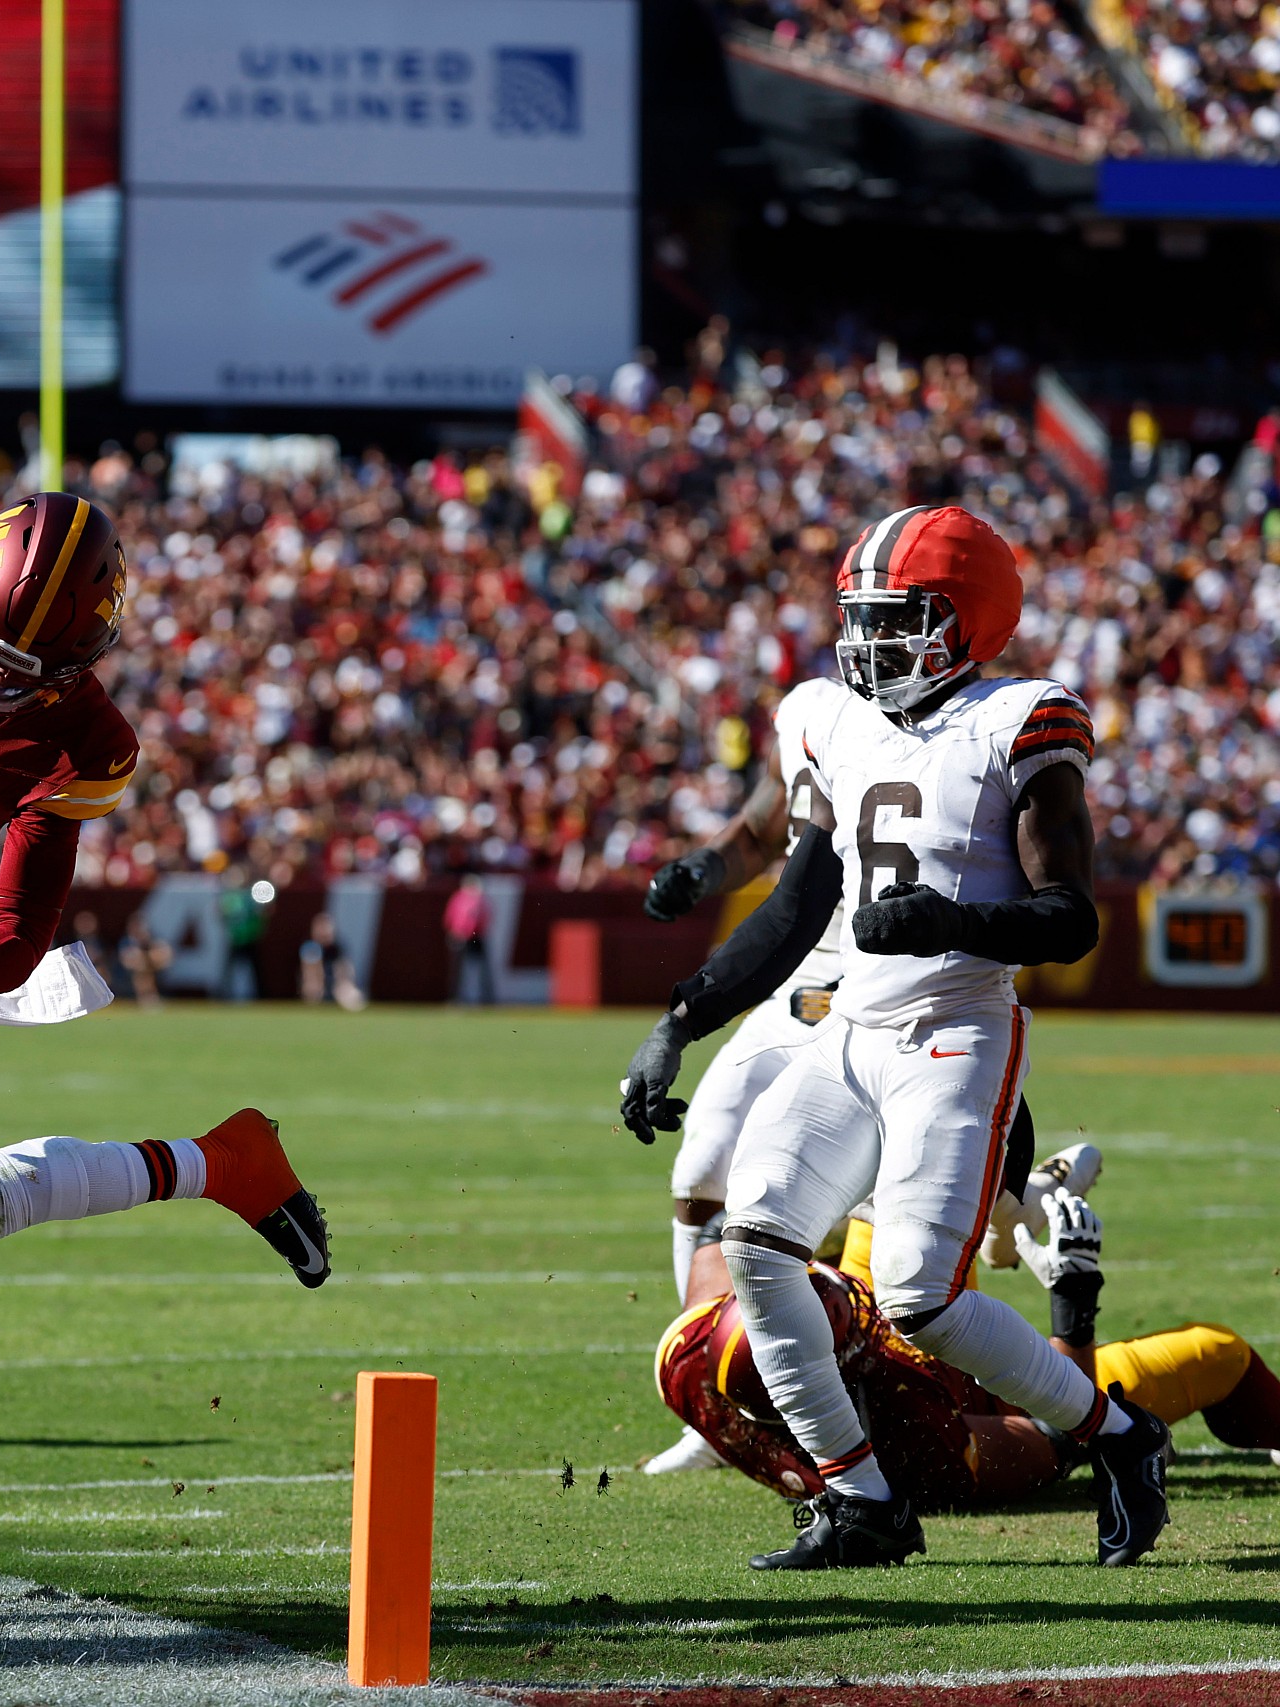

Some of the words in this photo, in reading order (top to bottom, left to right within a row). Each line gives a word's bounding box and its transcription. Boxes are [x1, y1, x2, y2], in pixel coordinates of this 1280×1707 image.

[238, 46, 474, 83] UNITED
[183, 88, 472, 126] AIRLINES
[856, 782, 923, 908] 6
